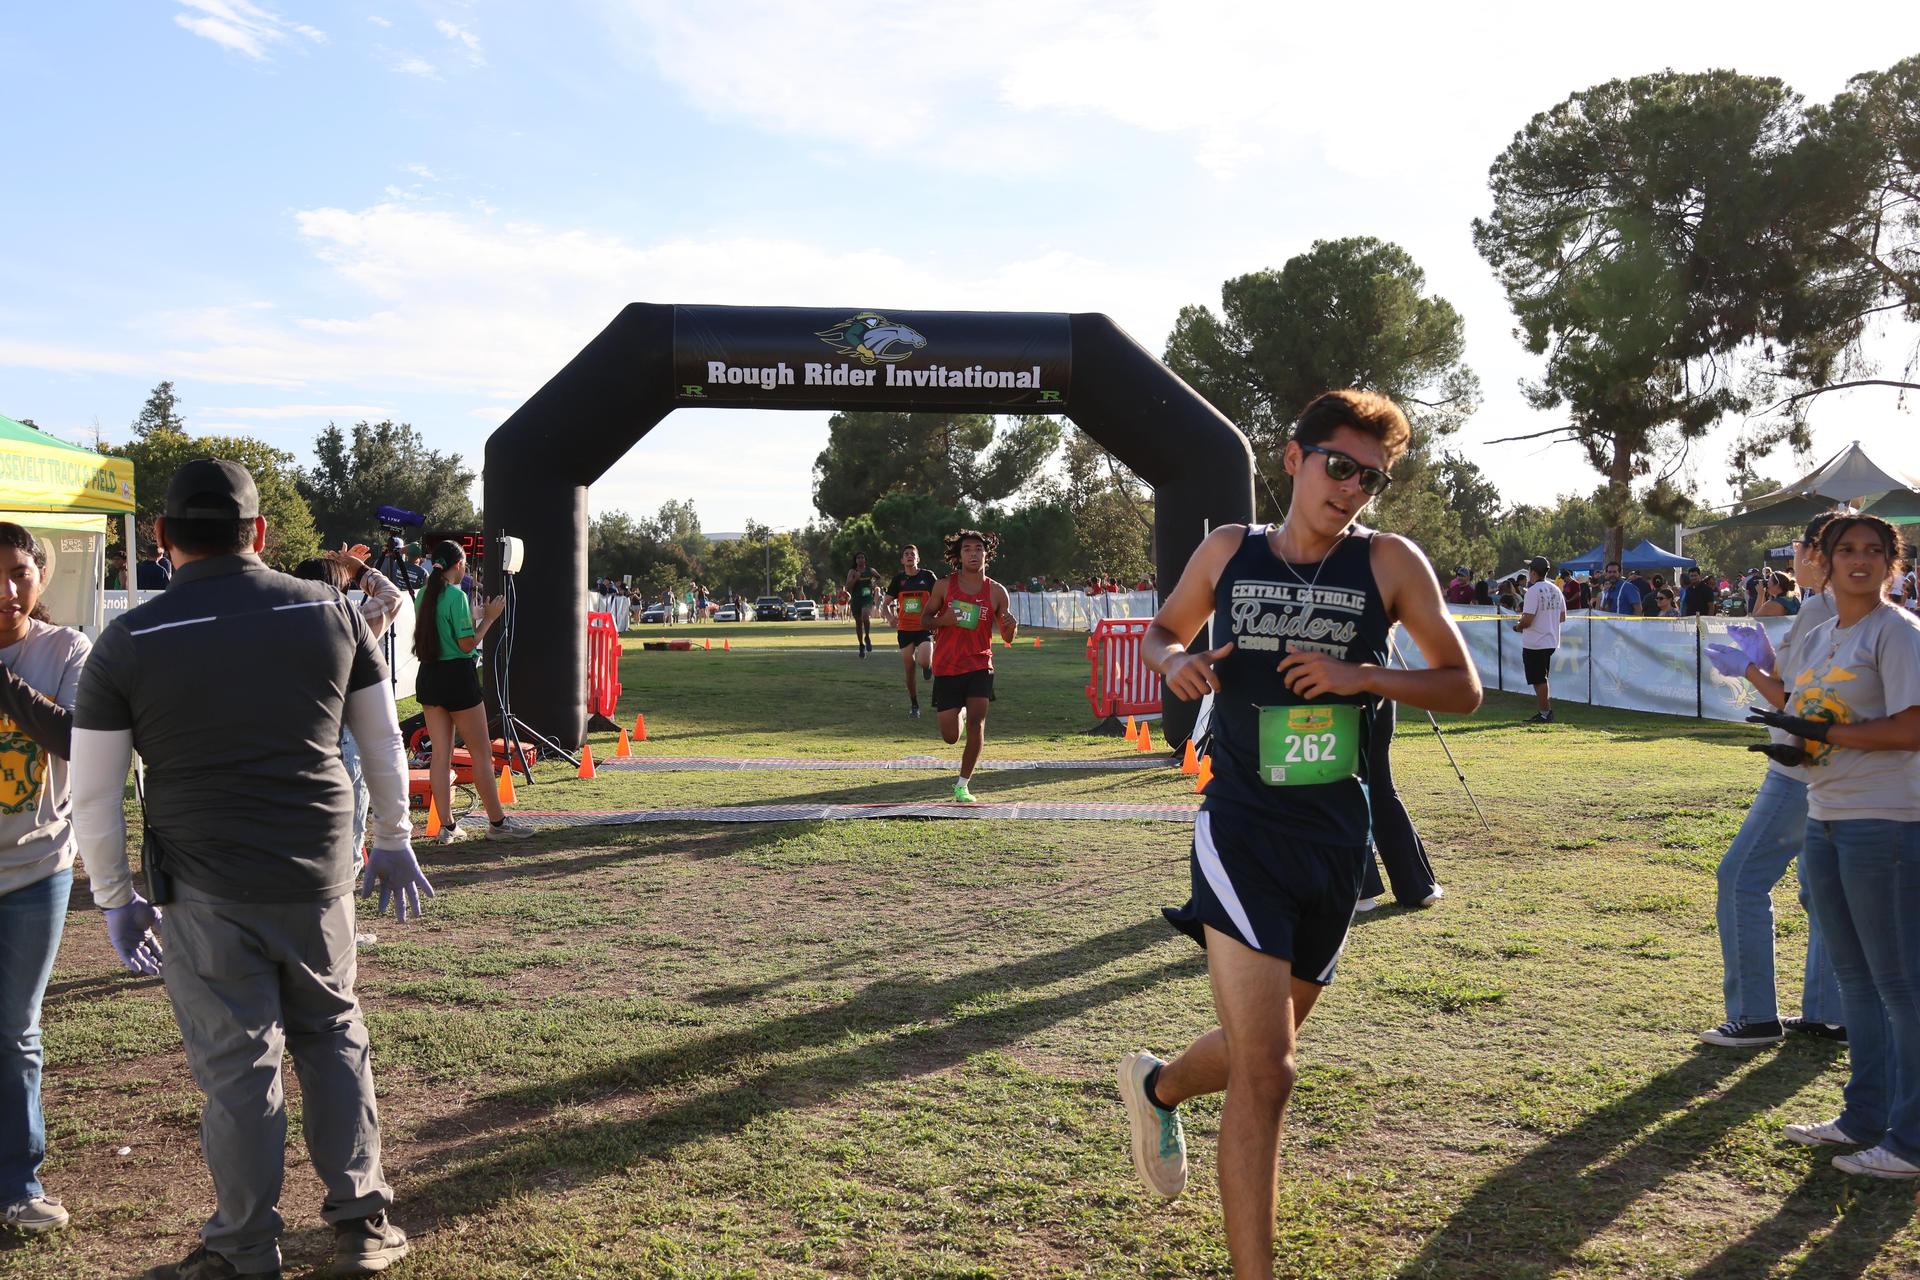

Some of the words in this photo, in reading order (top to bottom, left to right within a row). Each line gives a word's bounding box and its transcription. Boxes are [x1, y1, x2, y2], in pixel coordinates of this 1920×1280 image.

[708, 361, 795, 390] Rough
[804, 362, 876, 387] Rider
[885, 363, 1041, 389] Invitational
[48, 459, 81, 488] TRACK
[92, 466, 117, 494] FIELD
[1231, 584, 1292, 600] CENTRAL
[1296, 588, 1366, 610] CATHOLIC
[1230, 599, 1358, 643] Raiders
[1284, 733, 1336, 762] 262
